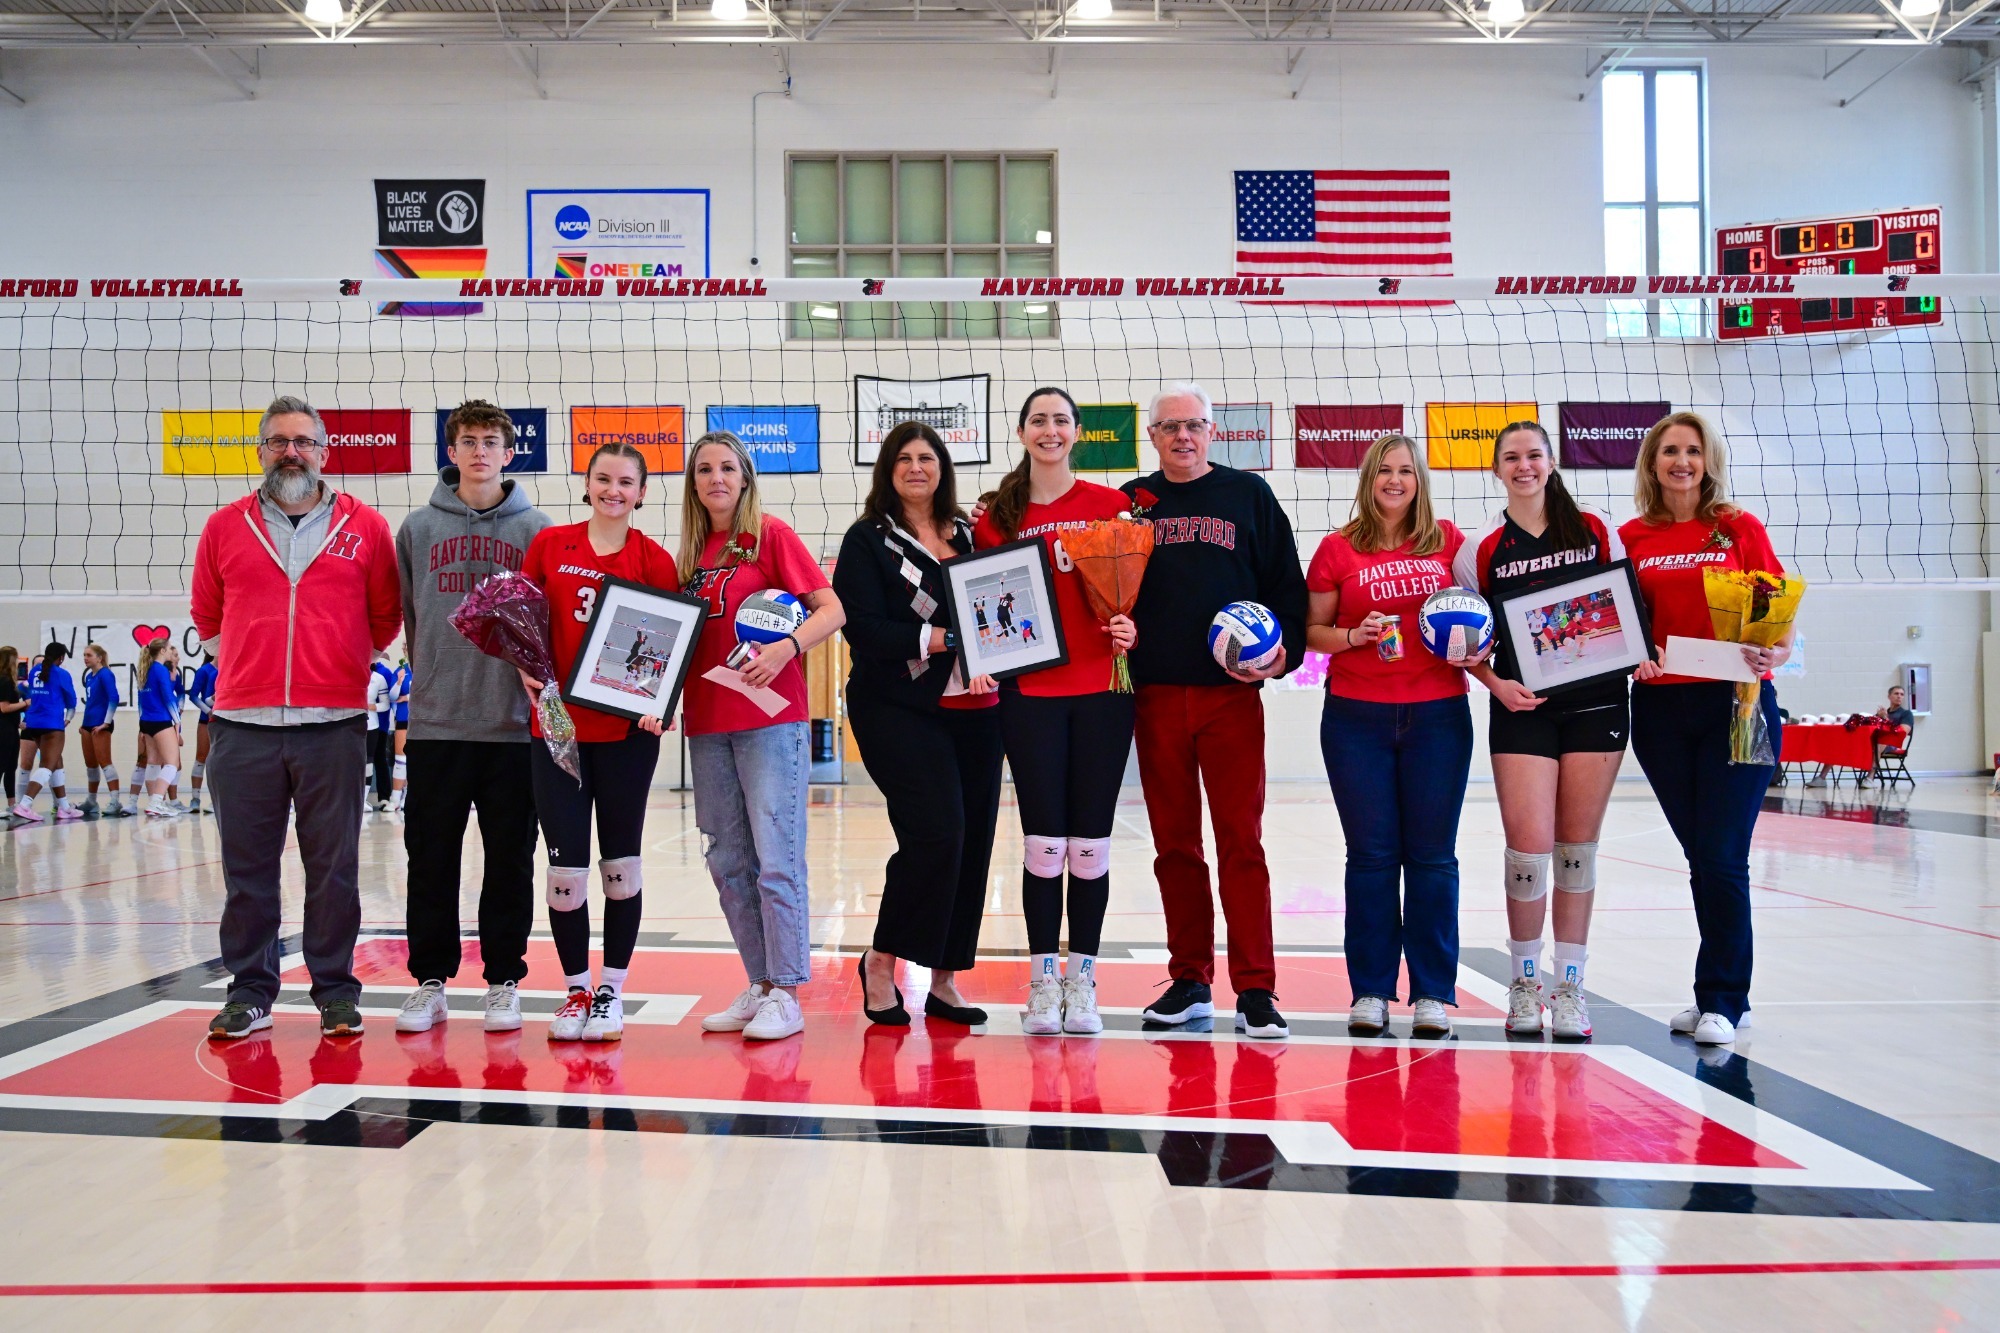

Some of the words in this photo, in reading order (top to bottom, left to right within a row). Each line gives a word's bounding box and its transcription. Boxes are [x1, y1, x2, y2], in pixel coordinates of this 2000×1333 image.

[387, 191, 427, 204] BLACK
[387, 206, 421, 218] LIVES
[388, 220, 434, 232] MATTER
[558, 221, 590, 232] NCAA
[598, 219, 655, 233] Division
[660, 219, 670, 233] III
[1883, 213, 1938, 230] VISITOR
[1725, 230, 1764, 245] HOME
[1915, 231, 1933, 259] 0
[1749, 247, 1765, 273] 0
[1807, 257, 1827, 266] POSS
[589, 263, 683, 277] ONETEAM
[1799, 265, 1835, 275] PERIOD
[1883, 264, 1917, 275] BONUS
[90, 279, 243, 297] VOLLEYBALL
[459, 279, 604, 297] HAVERFORD
[616, 279, 767, 296] VOLLEYBALL
[980, 278, 1124, 296] HAVERFORD
[1136, 278, 1284, 295] VOLLEYBALL
[1495, 276, 1637, 295] HAVERFORD
[1647, 275, 1795, 294] VOLLEYBALL
[1738, 305, 1752, 327] 0
[1876, 301, 1886, 316] 2
[1771, 310, 1780, 324] 2
[1871, 317, 1890, 327] TOL
[1766, 325, 1785, 335] TOL
[526, 424, 536, 437] &
[737, 424, 789, 436] JOHNS
[172, 435, 213, 449] BRYN
[577, 432, 678, 445] GETTYSBURG
[1148, 517, 1236, 550] VERFORD
[326, 530, 363, 560] H
[429, 534, 524, 573] HAVERFORD
[1495, 544, 1597, 579] HAVERFORD
[1638, 552, 1726, 572] HAVERFORD
[557, 564, 606, 581] HAVERF
[1358, 559, 1446, 587] HAVERFORD
[573, 586, 597, 624] 3
[1435, 597, 1468, 611] KIRA
